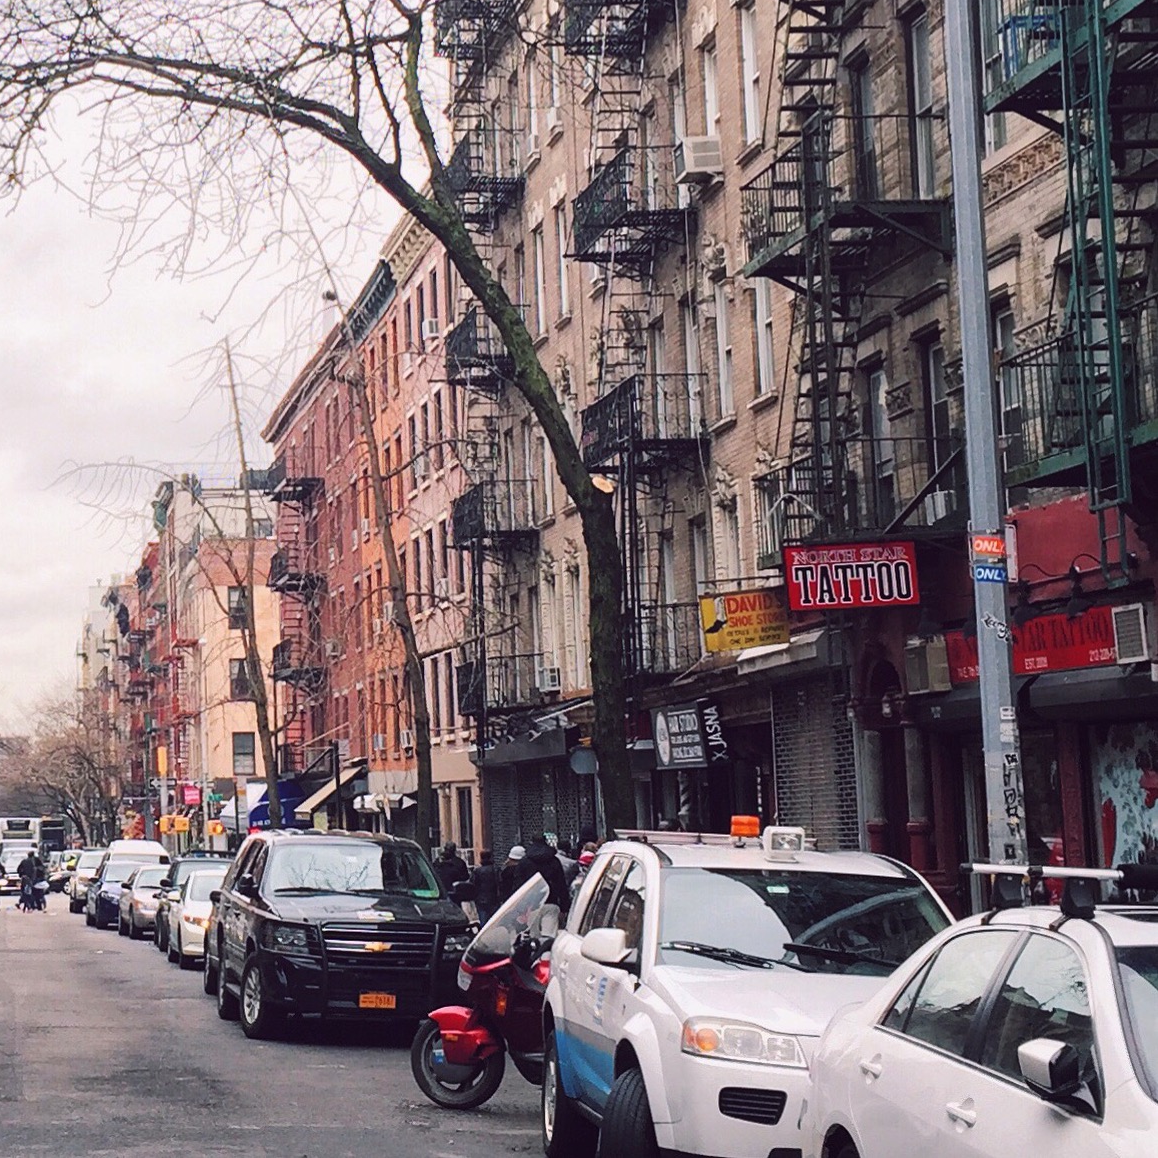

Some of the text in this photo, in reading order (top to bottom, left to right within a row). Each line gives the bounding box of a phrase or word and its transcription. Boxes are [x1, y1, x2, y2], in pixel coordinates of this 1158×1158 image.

[792, 547, 908, 564] NORTH STAR
[792, 560, 913, 606] TATTOO
[729, 615, 753, 628] SHOE
[703, 705, 727, 748] JASNA
